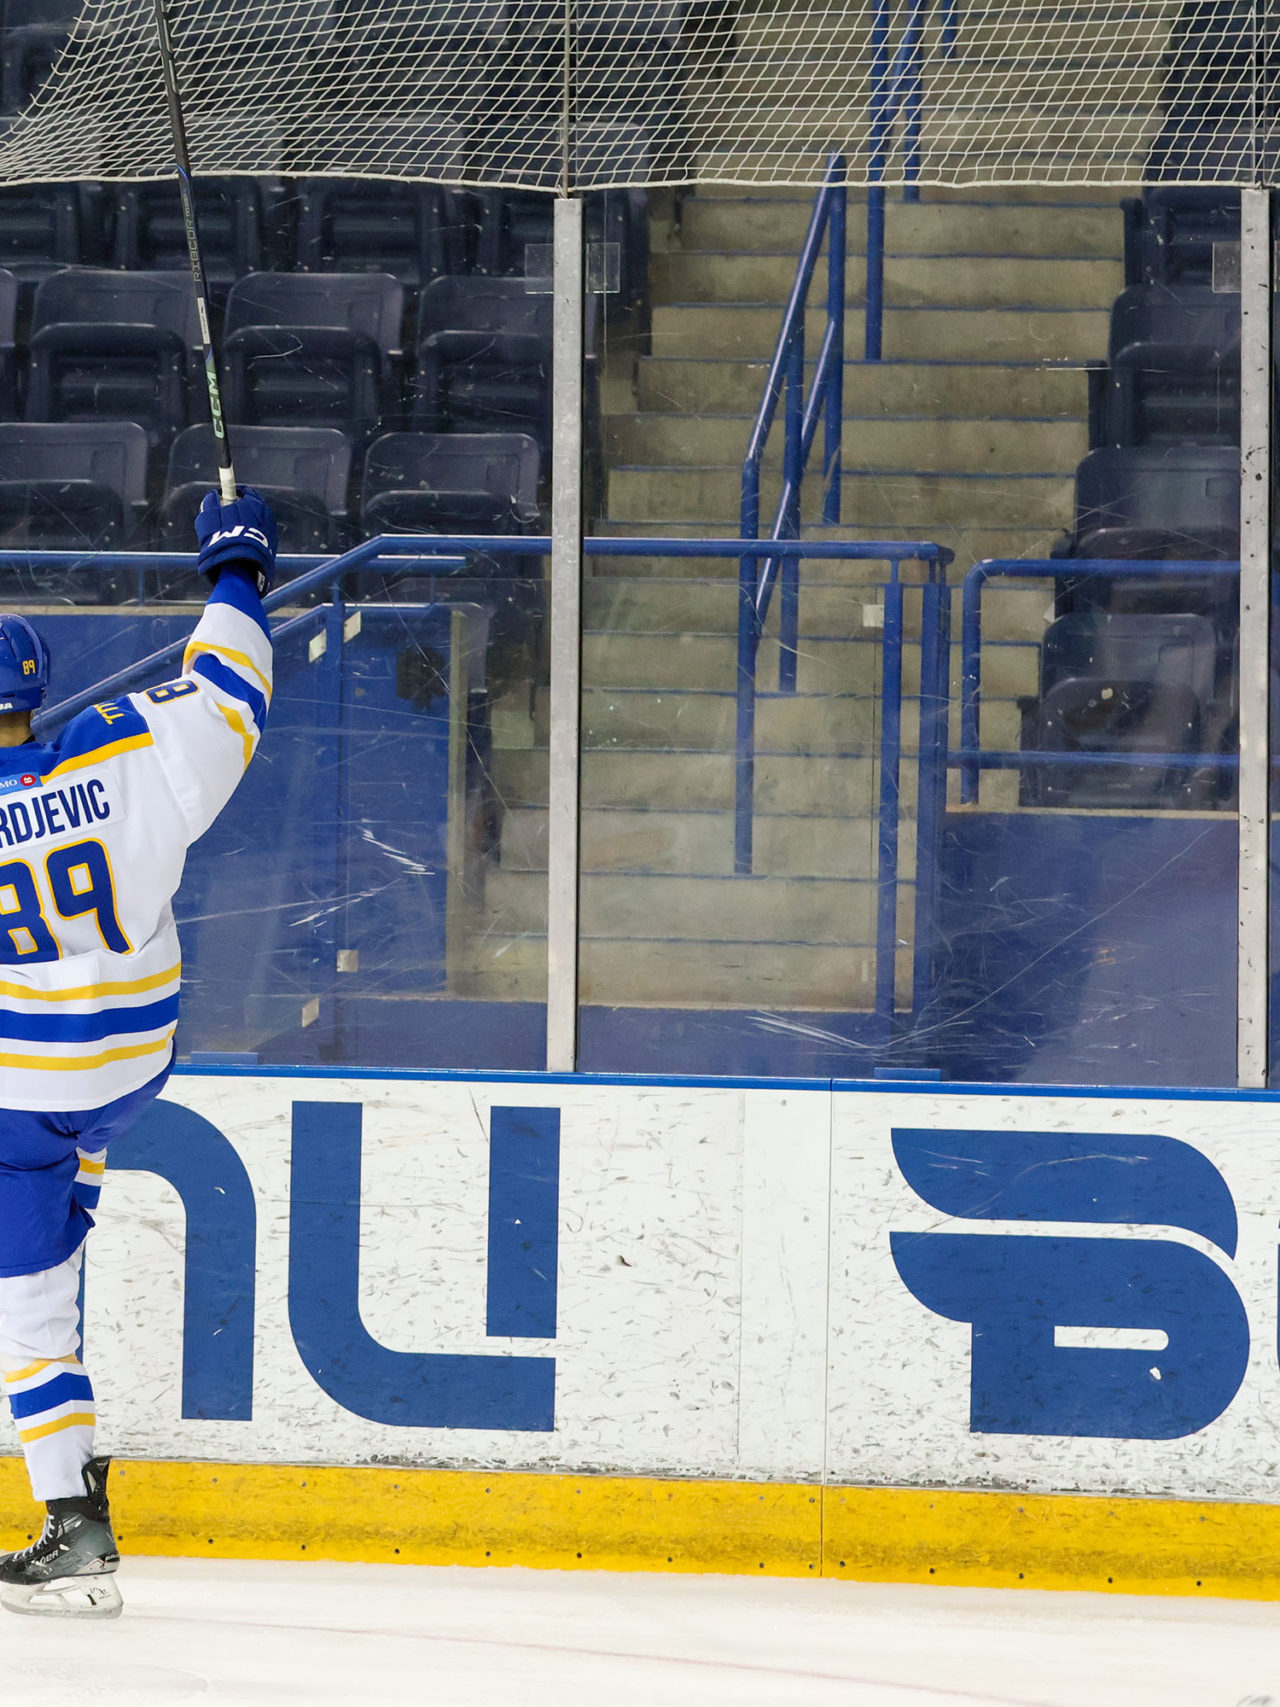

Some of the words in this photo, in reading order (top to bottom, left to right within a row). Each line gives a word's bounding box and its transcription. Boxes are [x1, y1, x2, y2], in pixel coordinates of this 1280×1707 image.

[207, 371, 224, 439] CCM
[208, 525, 272, 556] CM
[22, 660, 36, 675] 89
